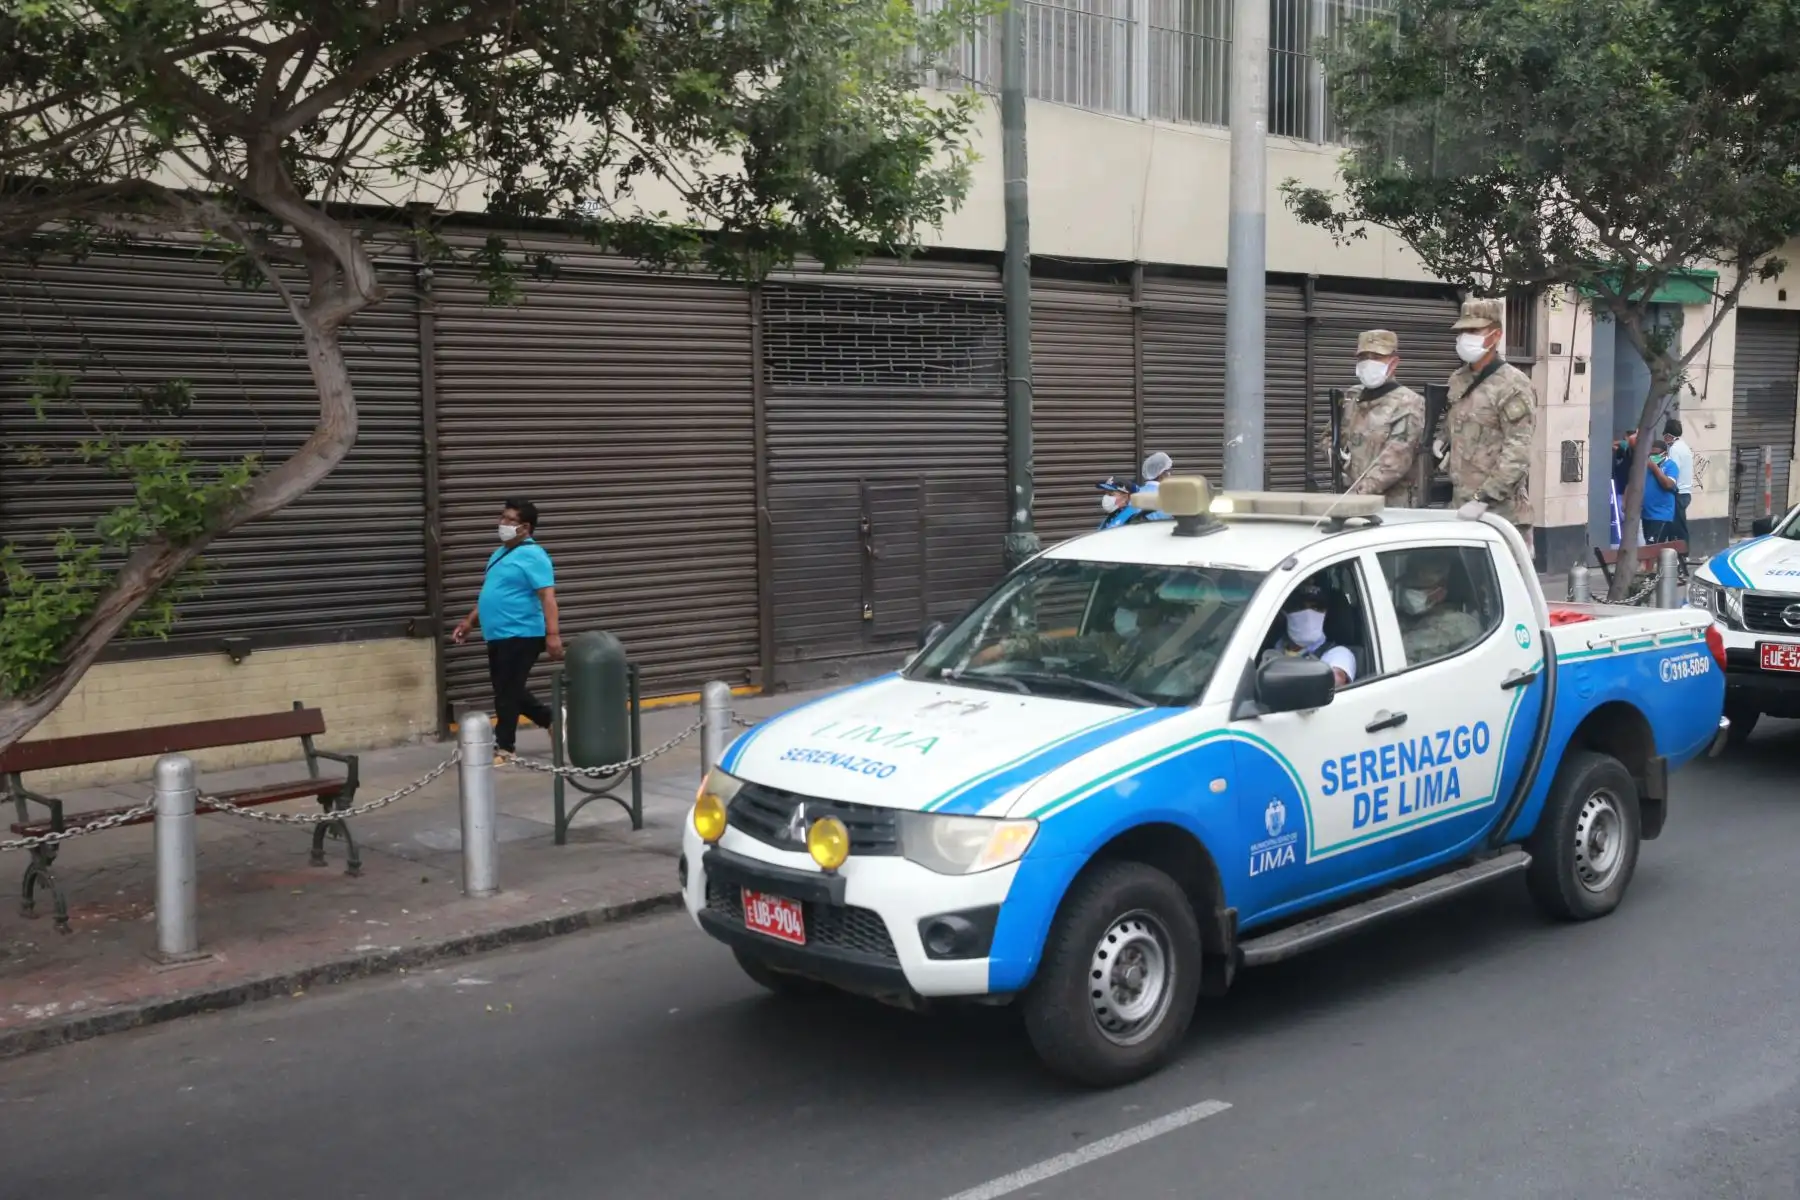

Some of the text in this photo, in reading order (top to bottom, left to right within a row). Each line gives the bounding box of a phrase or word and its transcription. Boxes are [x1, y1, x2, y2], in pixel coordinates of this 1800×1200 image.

[1671, 656, 1710, 680] 318-5050
[811, 722, 940, 755] LIMA
[780, 748, 897, 779] SERENAZGO
[1321, 721, 1490, 796] SERENAZGO
[1352, 766, 1461, 829] DE LIMA
[1250, 845, 1296, 877] LIMA
